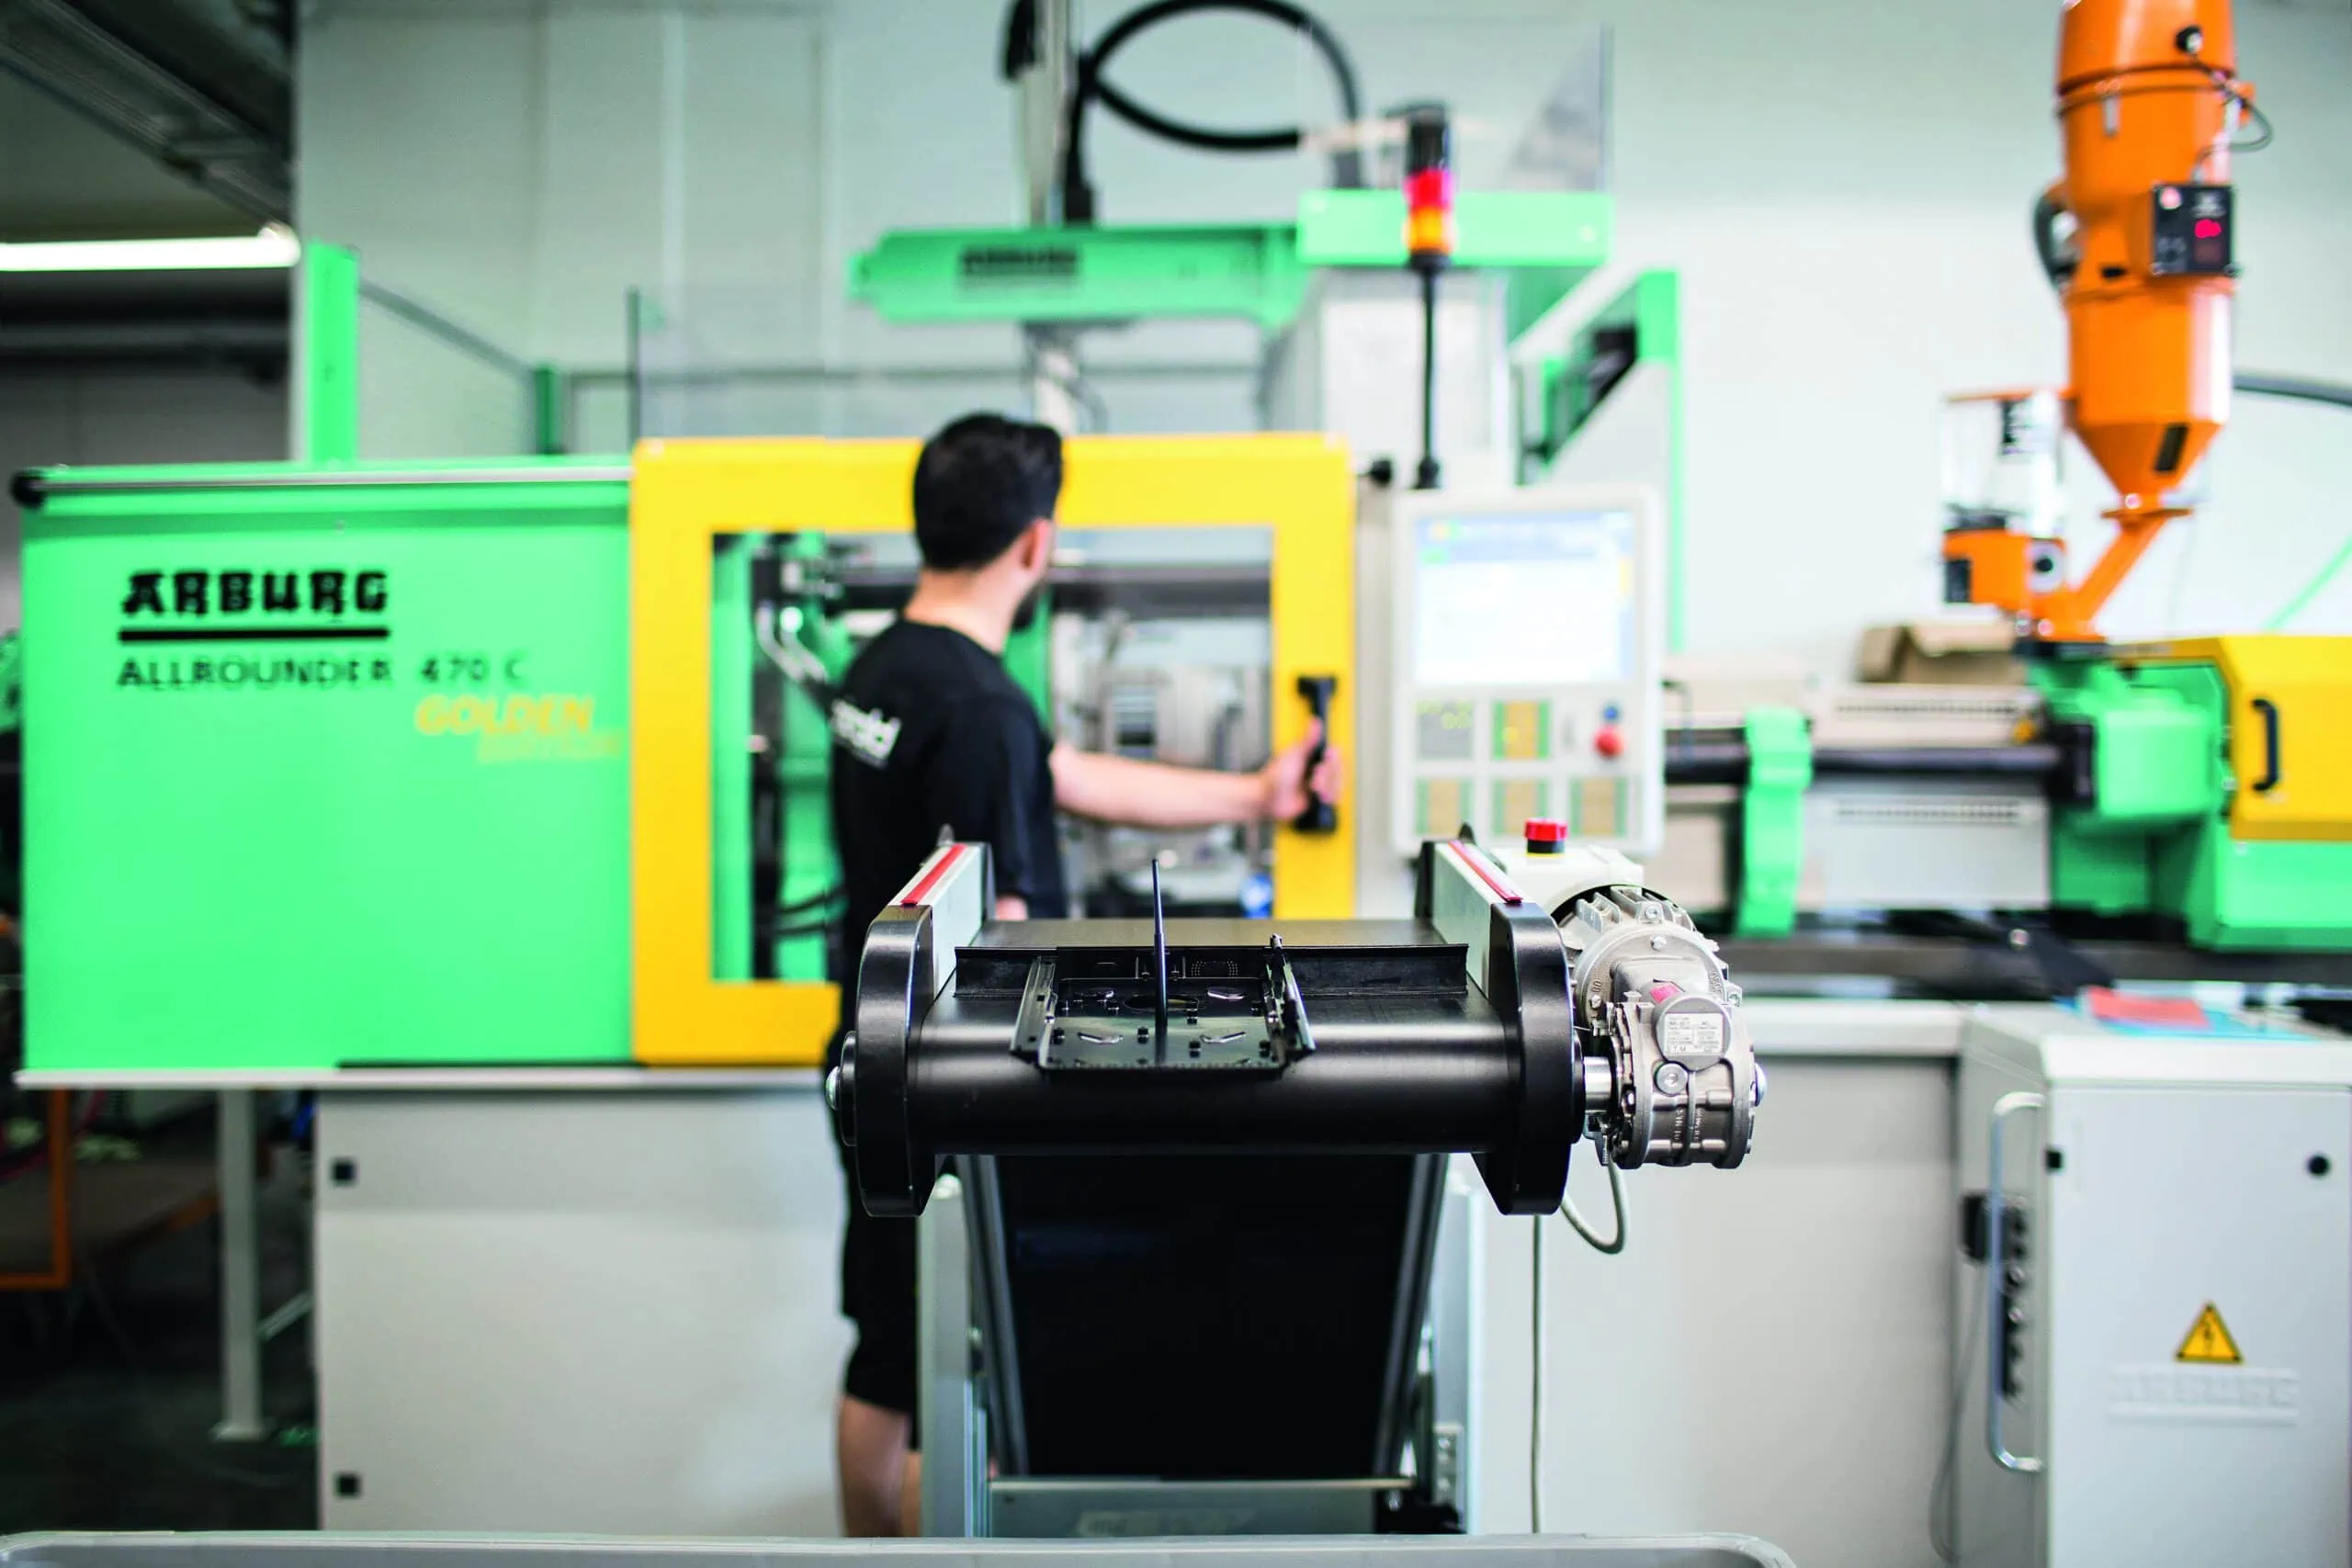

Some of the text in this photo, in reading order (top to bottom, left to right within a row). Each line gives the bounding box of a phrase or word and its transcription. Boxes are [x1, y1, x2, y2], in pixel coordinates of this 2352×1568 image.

[121, 570, 388, 617] ARBURG
[116, 656, 391, 691] ALLROUNDER
[420, 655, 489, 682] 470
[414, 694, 594, 735] GOLDEN
